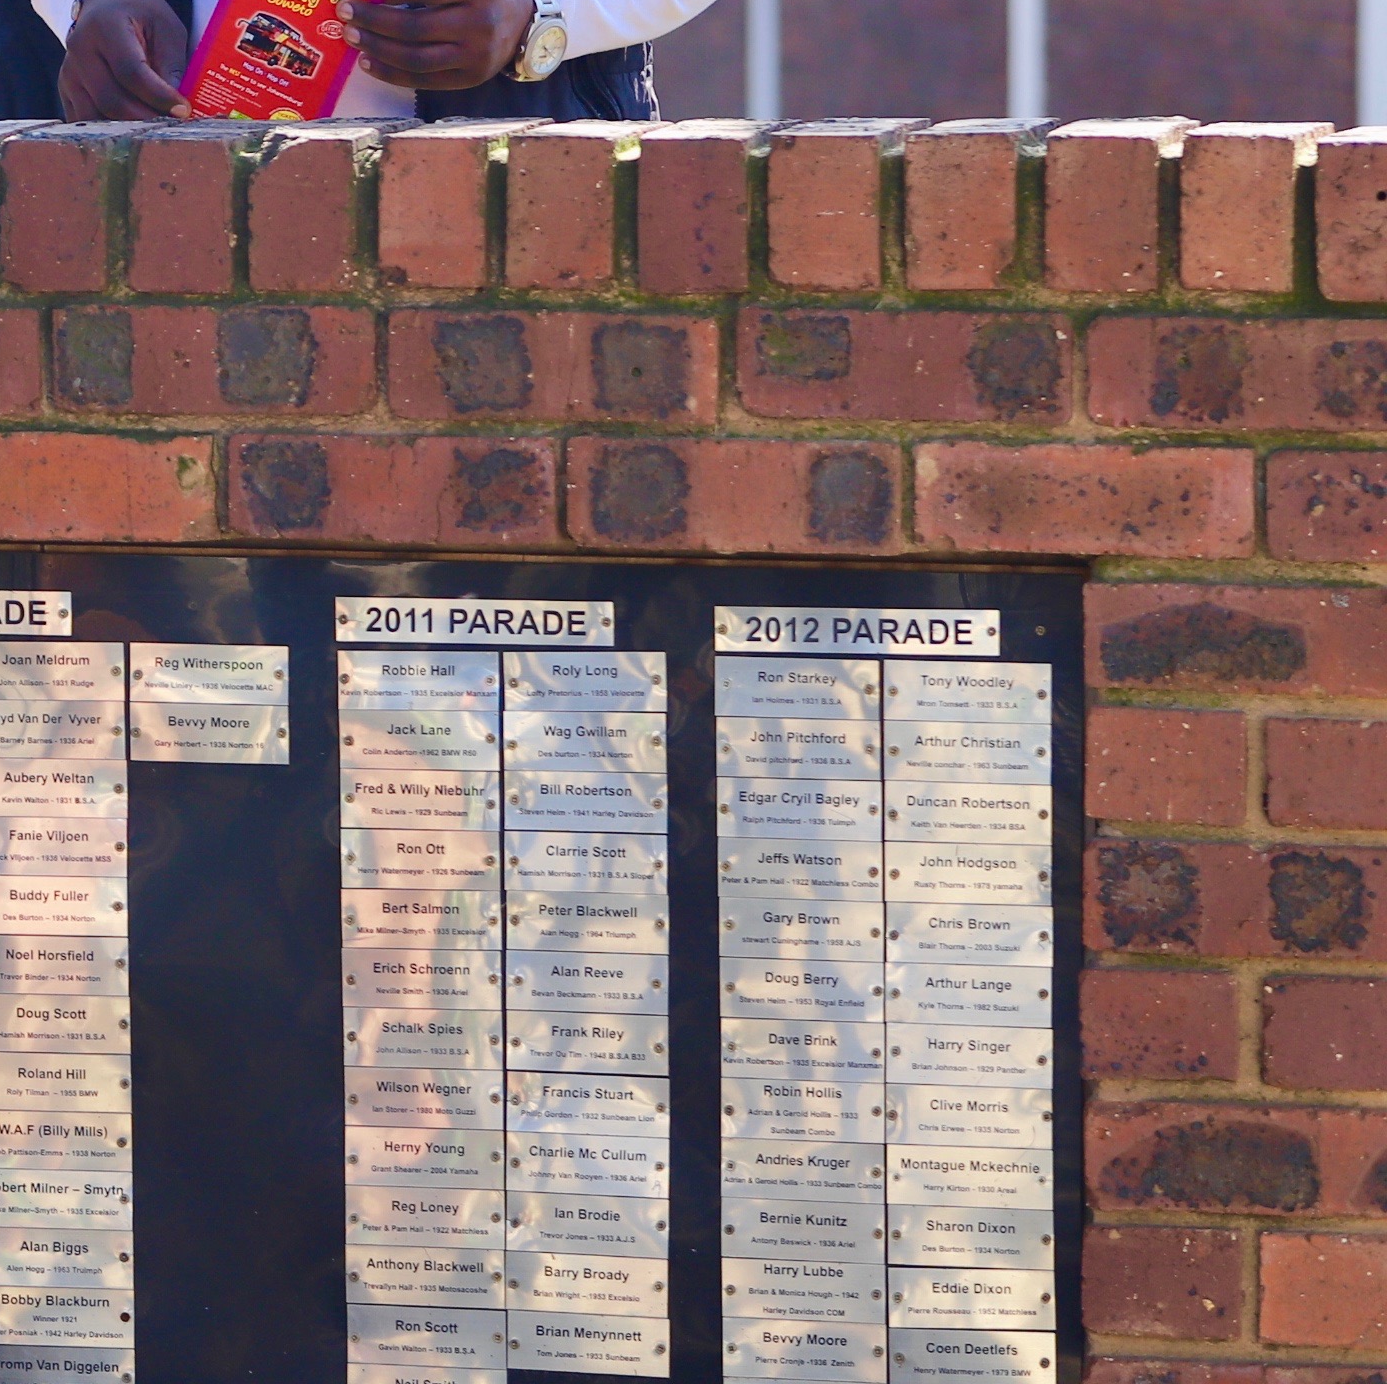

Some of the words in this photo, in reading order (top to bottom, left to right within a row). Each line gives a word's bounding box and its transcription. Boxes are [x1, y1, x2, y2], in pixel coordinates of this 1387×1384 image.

[365, 607, 434, 633] 2011
[449, 609, 587, 637] PARADE
[745, 616, 820, 643] 2012
[832, 617, 973, 645] PARADE
[1, 653, 32, 665] Joan
[35, 653, 90, 665] Meldrum
[154, 656, 179, 671] Reg
[182, 656, 263, 672] Witherspoon
[381, 664, 426, 676] Robbie
[430, 664, 455, 676] Hall
[919, 674, 953, 689] Tony
[955, 675, 1014, 690] Woodley
[16, 712, 38, 723] Van
[41, 712, 62, 724] Der
[67, 713, 101, 726] Vyver
[167, 715, 206, 730] Bevvy
[210, 716, 250, 728] Moore
[386, 723, 417, 735] Jack
[419, 723, 451, 736] Lane
[749, 730, 783, 742] John
[786, 731, 846, 744] Pitchford
[539, 783, 561, 795] Bill
[564, 783, 632, 796] Robertson
[757, 852, 790, 864] Jeffs
[792, 853, 842, 866] Watson
[8, 888, 49, 904] Buddy
[53, 889, 89, 901] Fuller
[381, 901, 409, 914] Bert
[411, 902, 459, 914] Salmon
[538, 903, 572, 916] Peter
[575, 904, 637, 918] Blackwell
[762, 910, 793, 926] Gary
[797, 912, 840, 924] Brown
[5, 948, 34, 960] Noel
[37, 949, 94, 961] Horsfield
[381, 1021, 424, 1034] Schalk
[427, 1022, 463, 1036] Spies
[550, 1024, 588, 1037] Frank
[591, 1026, 624, 1042] Riley
[767, 1032, 800, 1045] Dave
[803, 1033, 837, 1046] Brink
[925, 1036, 964, 1053] Harry
[967, 1038, 1011, 1054] Singer
[929, 1098, 963, 1111] Clive
[966, 1099, 1009, 1113] Morris
[554, 1206, 573, 1219] Ian
[577, 1208, 620, 1222] Brodie
[925, 1219, 973, 1232] Sharon
[977, 1221, 1015, 1234] Dixon
[19, 1240, 49, 1252] Alan
[51, 1240, 89, 1256] Biggs
[0, 1293, 41, 1308] Bobby
[45, 1294, 110, 1307] Blackburn
[394, 1319, 421, 1331] Ron
[423, 1320, 458, 1334] Scott
